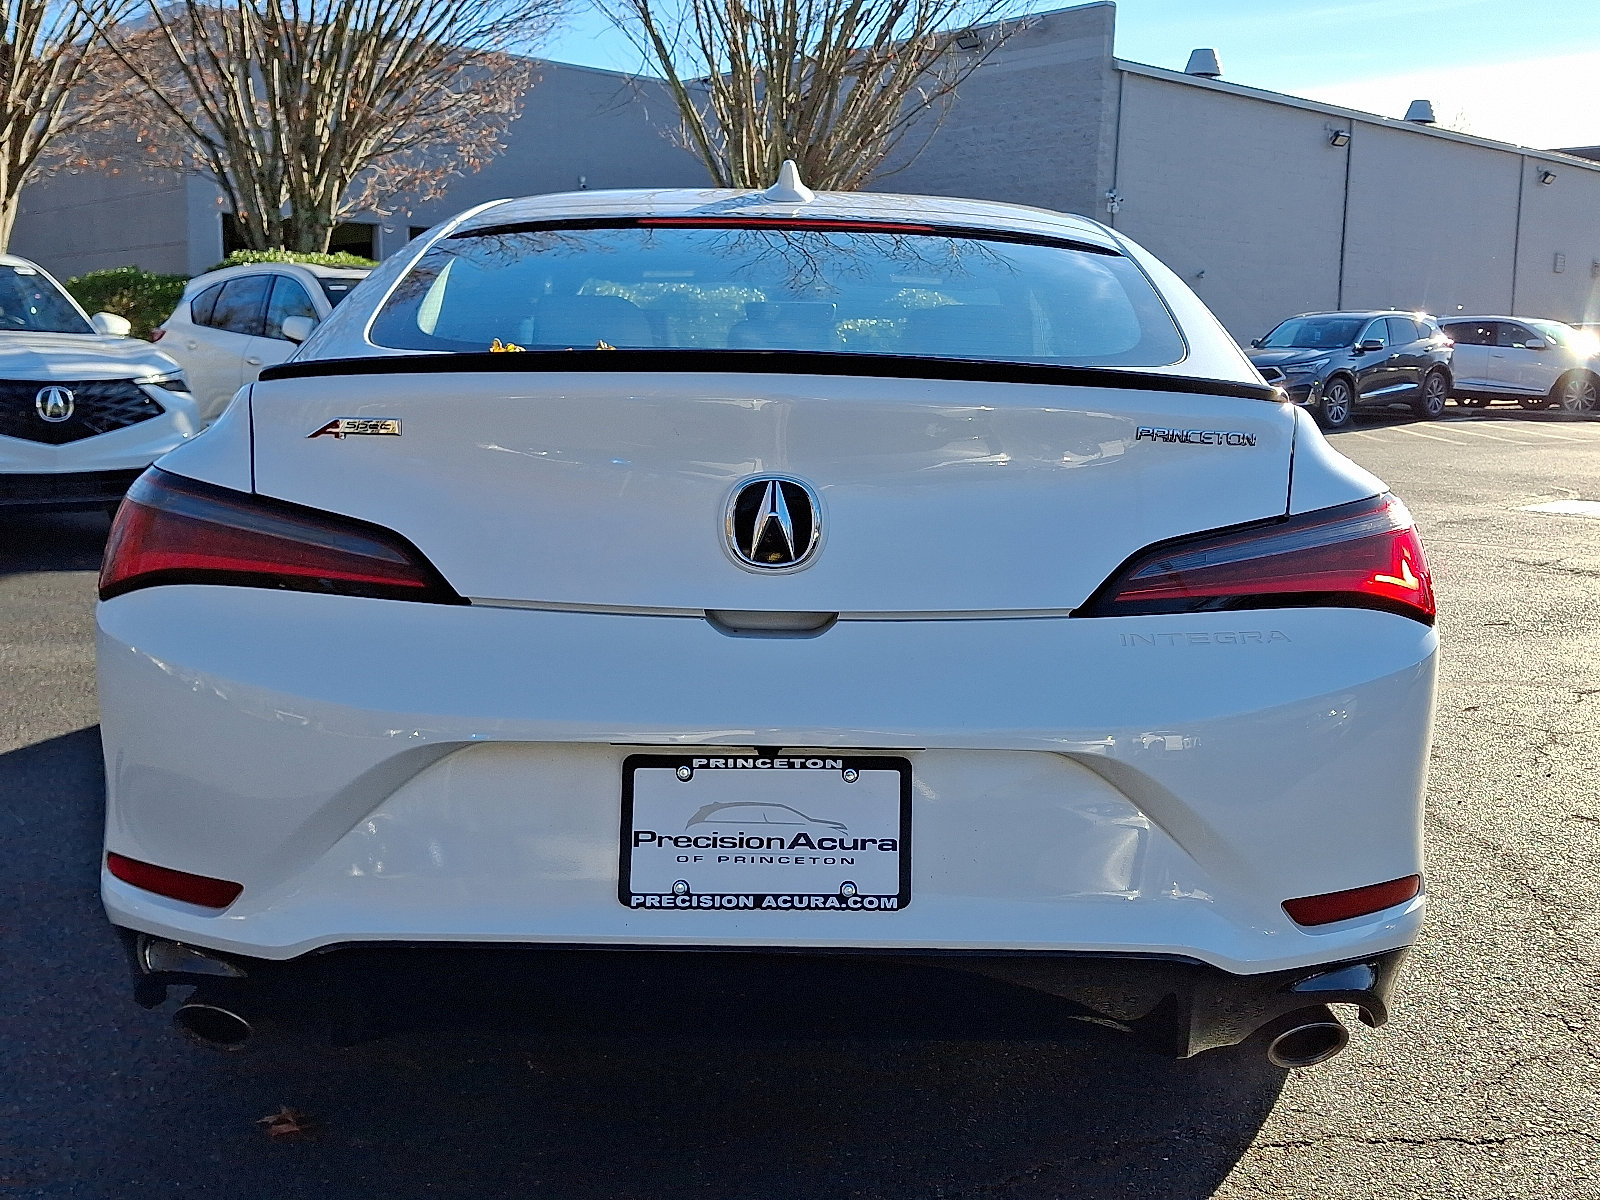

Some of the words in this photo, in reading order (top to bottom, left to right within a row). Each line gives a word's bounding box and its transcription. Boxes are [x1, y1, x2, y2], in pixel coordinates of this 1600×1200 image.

[1136, 427, 1257, 447] PRINCETON
[1119, 630, 1292, 647] INTEGRA
[692, 758, 843, 769] PRINCETON
[676, 855, 704, 863] OF
[717, 855, 856, 865] PRINCETON
[630, 895, 754, 908] PRECISION
[761, 896, 898, 909] ACURA.COM
